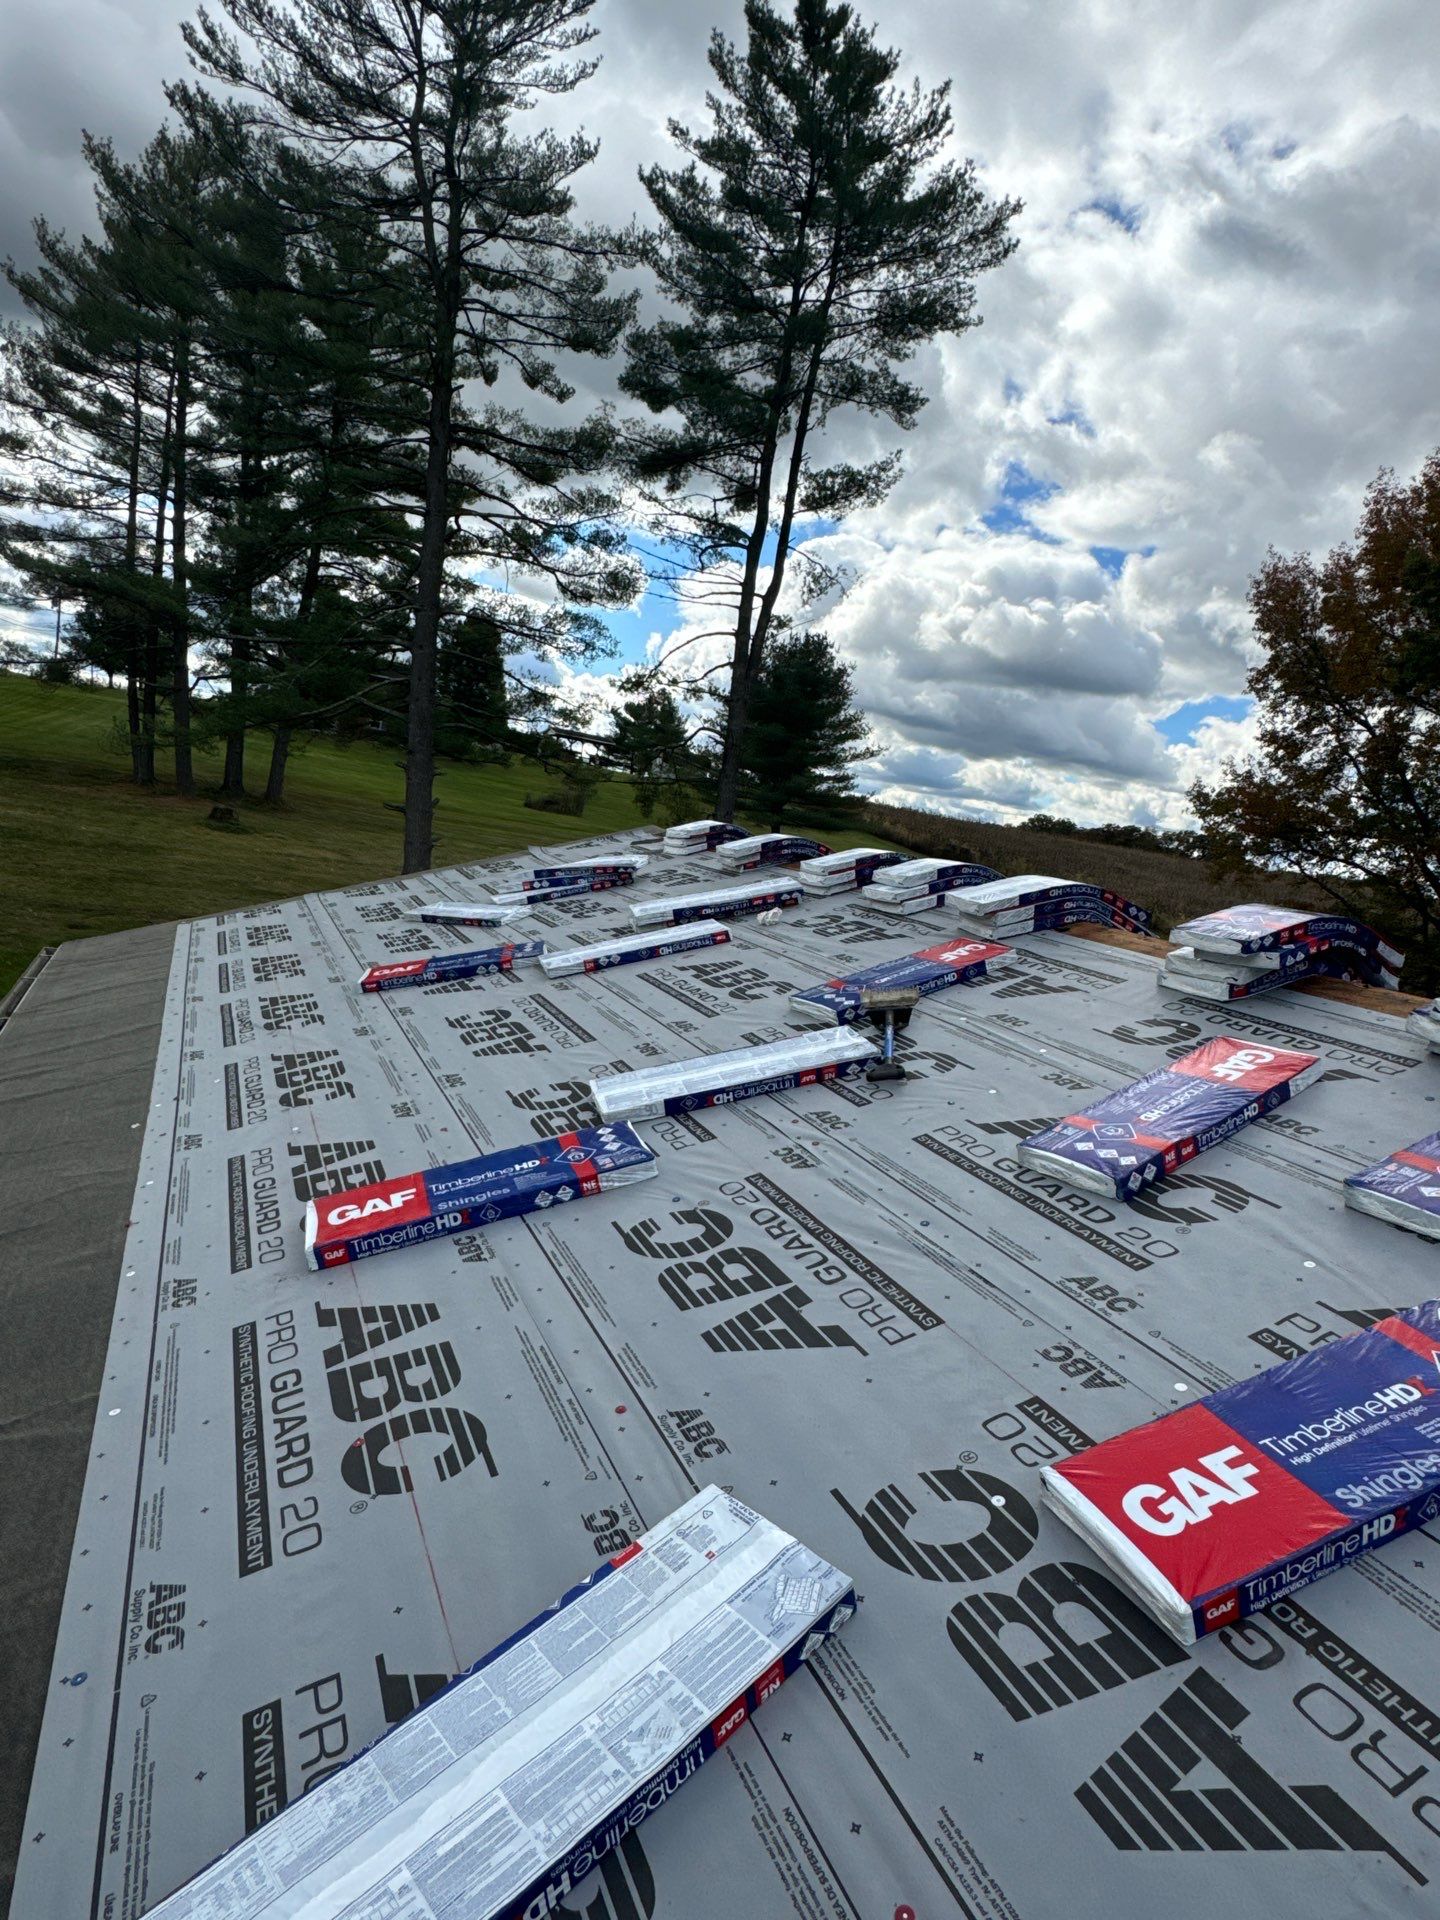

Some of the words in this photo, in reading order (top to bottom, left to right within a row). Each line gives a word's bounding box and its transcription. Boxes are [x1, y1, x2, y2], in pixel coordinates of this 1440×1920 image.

[373, 963, 422, 977] GAF
[940, 943, 987, 962] GAF
[917, 972, 958, 992] berlineHD
[1064, 972, 1112, 990] PRO
[1162, 1002, 1206, 1016] 20
[756, 1026, 787, 1041] PR
[1206, 1014, 1321, 1050] GUARD
[271, 1050, 356, 1108] ABC
[824, 1071, 836, 1080] NE
[1210, 1050, 1275, 1082] GAF
[1325, 1050, 1406, 1075] PRO
[244, 1074, 265, 1109] GUARD
[856, 1083, 894, 1100] 20
[248, 1109, 267, 1125] 20
[651, 1121, 696, 1150] PRO
[1181, 1144, 1194, 1156] GAF
[251, 1147, 274, 1176] PRO
[1165, 1151, 1176, 1163] NE
[437, 1187, 511, 1210] Shingles
[583, 1179, 598, 1191] NE
[719, 1181, 760, 1206] 20
[916, 1135, 977, 1171] SYNTHETIC
[973, 1167, 1028, 1201] ROOFING
[1027, 1199, 1147, 1269] UNDERLAYMENT
[933, 1125, 996, 1158] PRO
[992, 1157, 1116, 1224] GUARD
[1115, 1227, 1180, 1258] 20
[253, 1177, 281, 1235] GUARD
[327, 1188, 417, 1226] GAF
[751, 1176, 822, 1235] UNDERLAYMENT
[258, 1236, 285, 1264] 20
[324, 1248, 346, 1260] GAF
[750, 1207, 848, 1285] GUARD
[820, 1232, 869, 1272] ROOFING
[611, 1209, 868, 1357] ABC
[864, 1269, 938, 1328] SYNTHETIC
[1060, 1276, 1144, 1313] ABC
[839, 1287, 917, 1346] PRO
[264, 1309, 299, 1365] PRO
[238, 1325, 254, 1393] SYNTHETIC
[1035, 1344, 1126, 1389] ABC
[240, 1394, 258, 1438] ROOFING
[315, 1301, 498, 1495] ABC
[270, 1368, 314, 1489] GUARD
[657, 1414, 678, 1439] Supply
[665, 1408, 732, 1458] ABC
[982, 1412, 1060, 1467] 20
[1289, 1452, 1316, 1466] High
[1122, 1445, 1260, 1537] GAF
[1334, 1453, 1440, 1508] Shingles
[241, 1440, 265, 1570] UNDERLAYMENT
[280, 1495, 322, 1558] 20
[132, 1588, 146, 1625] Supply
[145, 1582, 186, 1654] ABC
[1206, 1599, 1235, 1620] GAF
[1250, 1595, 1271, 1612] High
[760, 1678, 781, 1701] NE
[829, 1467, 1430, 1886] ABC
[718, 1708, 745, 1736] GAF
[251, 1708, 277, 1824] SYNTHE
[112, 1792, 124, 1832] OVERLAP
[937, 1820, 954, 1841] ASTM
[988, 1878, 1007, 1902] ASTM
